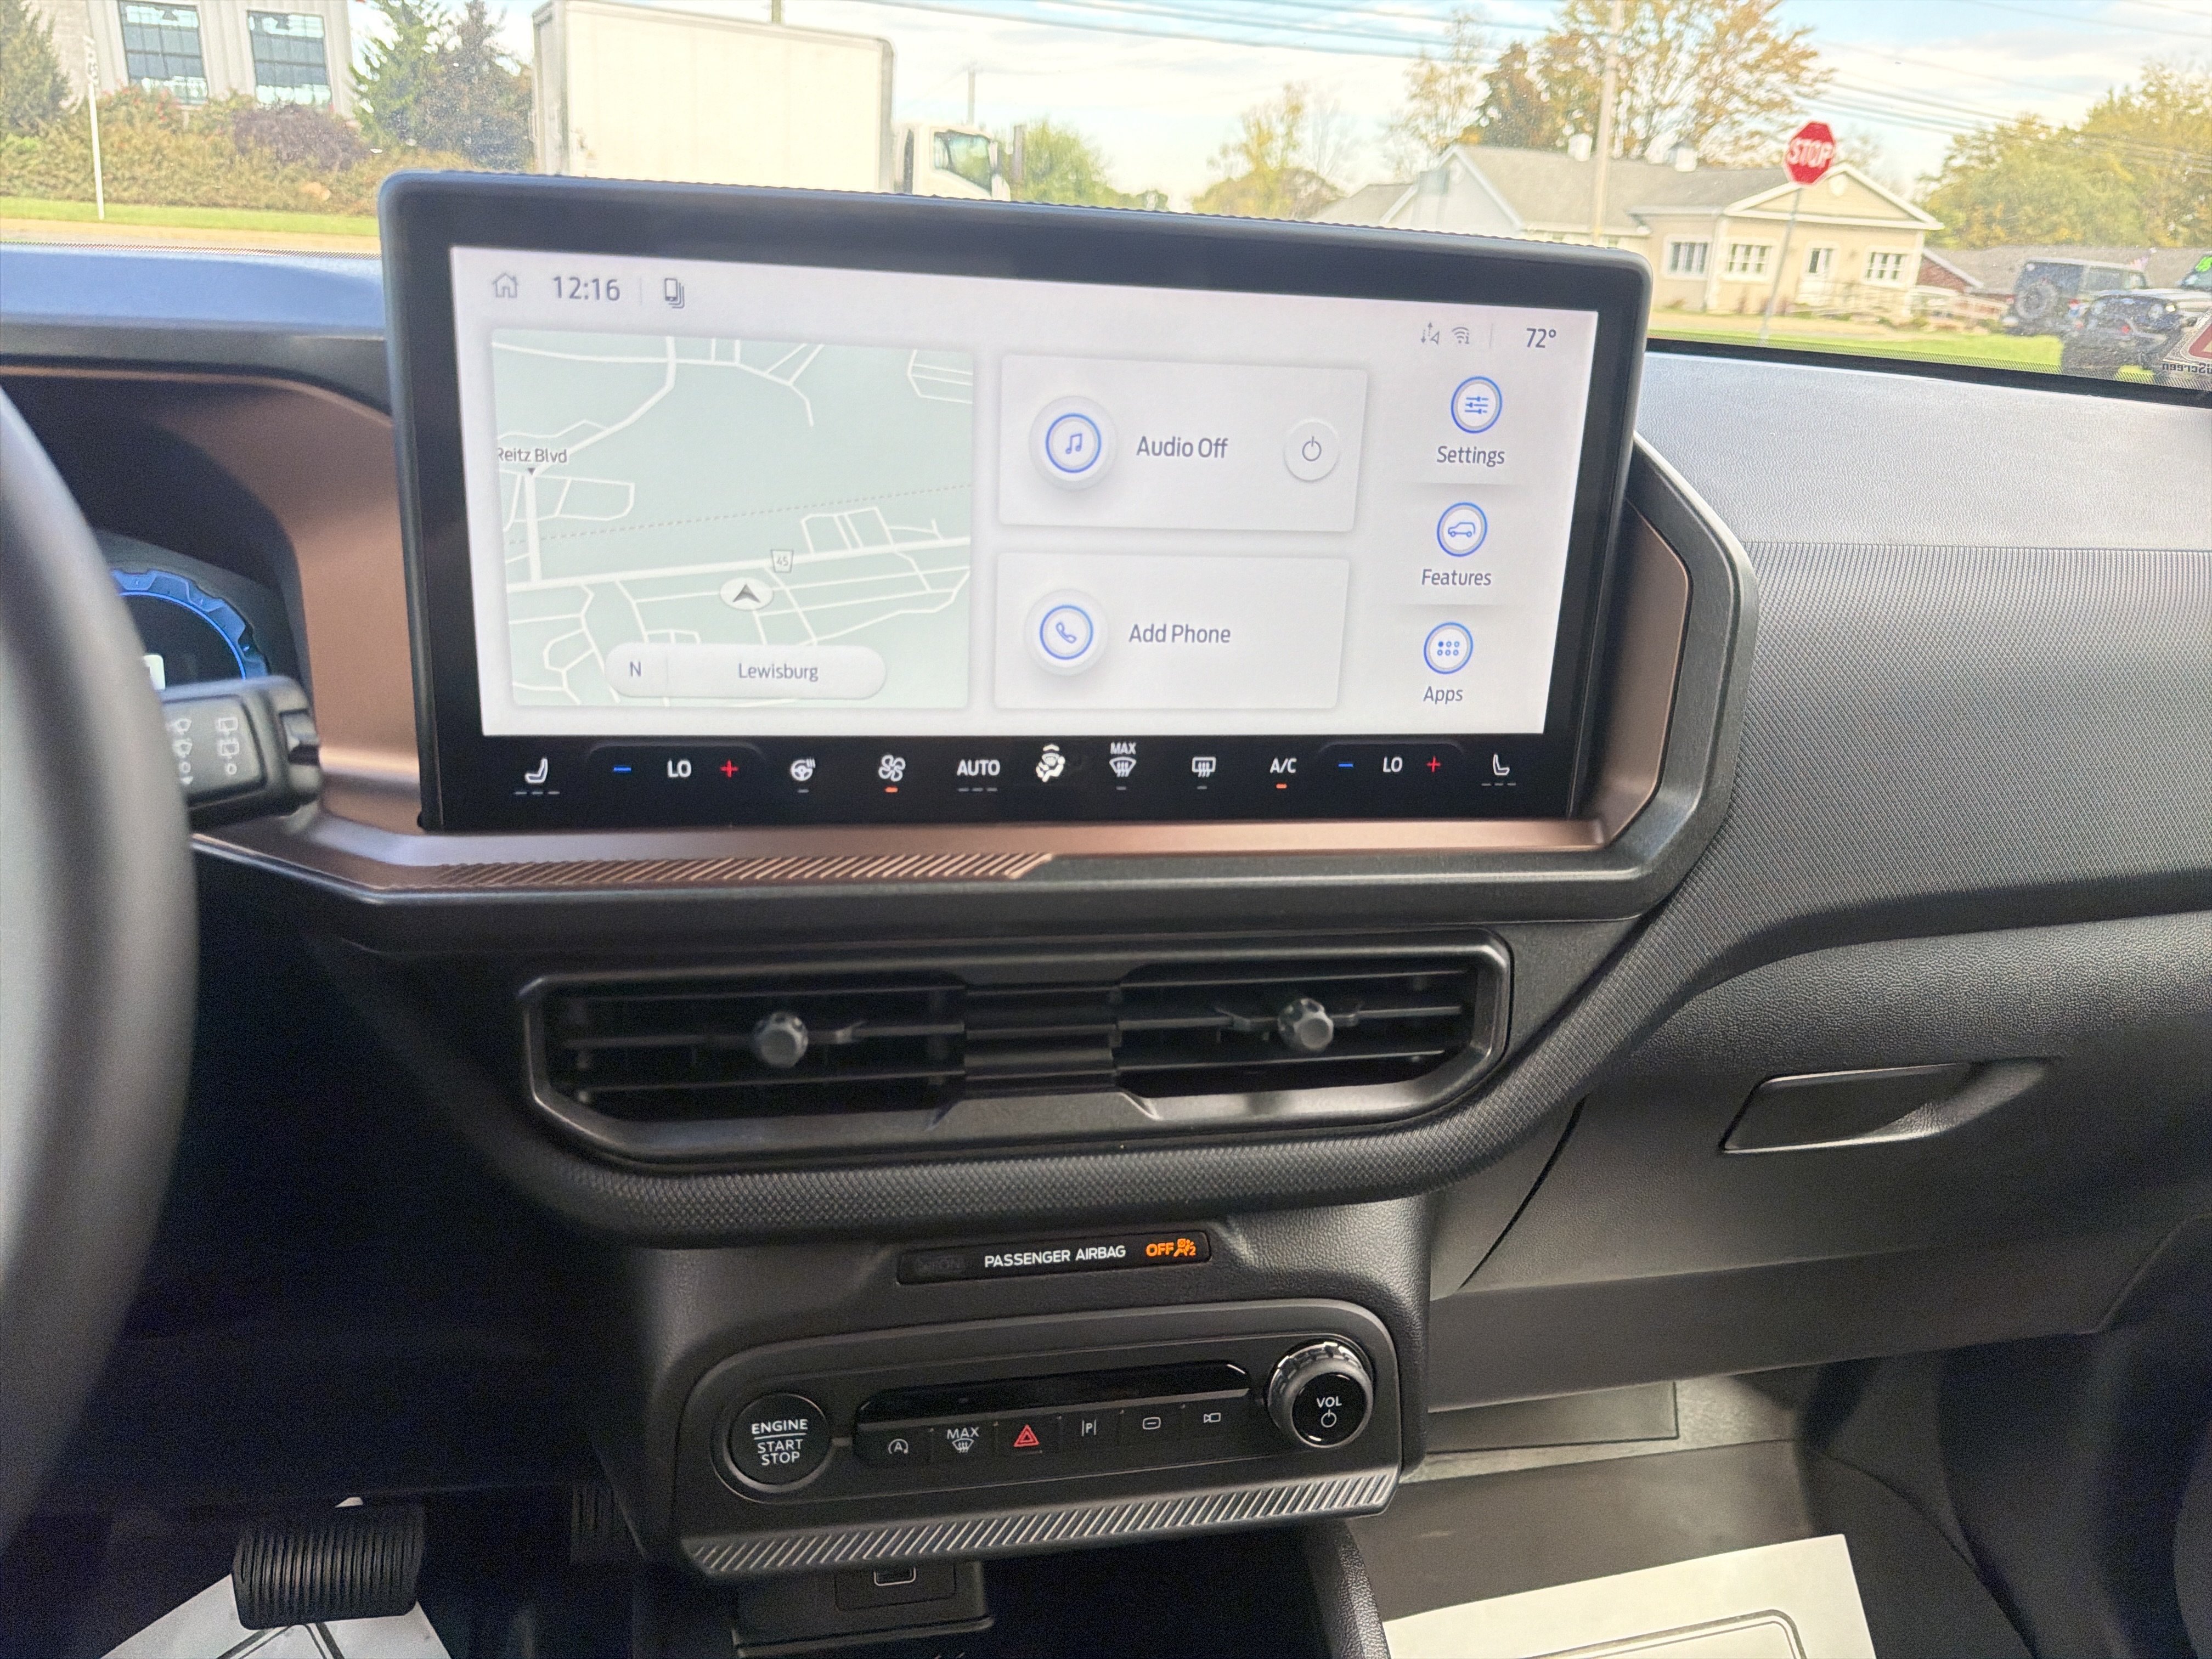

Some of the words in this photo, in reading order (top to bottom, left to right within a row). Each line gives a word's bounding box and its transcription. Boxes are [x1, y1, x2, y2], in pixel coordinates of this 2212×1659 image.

[1786, 137, 1834, 168] STOP
[552, 276, 621, 301] 12:16
[1526, 328, 1557, 348] 72°
[1136, 436, 1194, 458] Audio
[1198, 438, 1228, 458] Off
[535, 448, 568, 464] Blvd
[1436, 445, 1505, 467] Settings
[776, 556, 789, 567] 45
[1421, 569, 1492, 586] Features
[1128, 624, 1167, 643] Add
[1171, 624, 1231, 643] Phone
[629, 661, 642, 677] N
[738, 663, 819, 681] Lewisburg
[1423, 686, 1463, 704] Apps
[1110, 742, 1137, 755] MAX
[667, 759, 692, 778] LO
[956, 759, 1001, 776] AUTO
[1269, 758, 1297, 774] A/C
[1383, 756, 1403, 773] LO
[984, 1249, 1071, 1268] PASSENGER
[1075, 1244, 1127, 1261] AIRBAG
[1146, 1242, 1175, 1257] OFF
[1316, 1396, 1342, 1408] VOL
[752, 1419, 809, 1435] ENGINE
[947, 1426, 980, 1440] MAX
[757, 1438, 804, 1455] START
[761, 1451, 800, 1466] STOP
